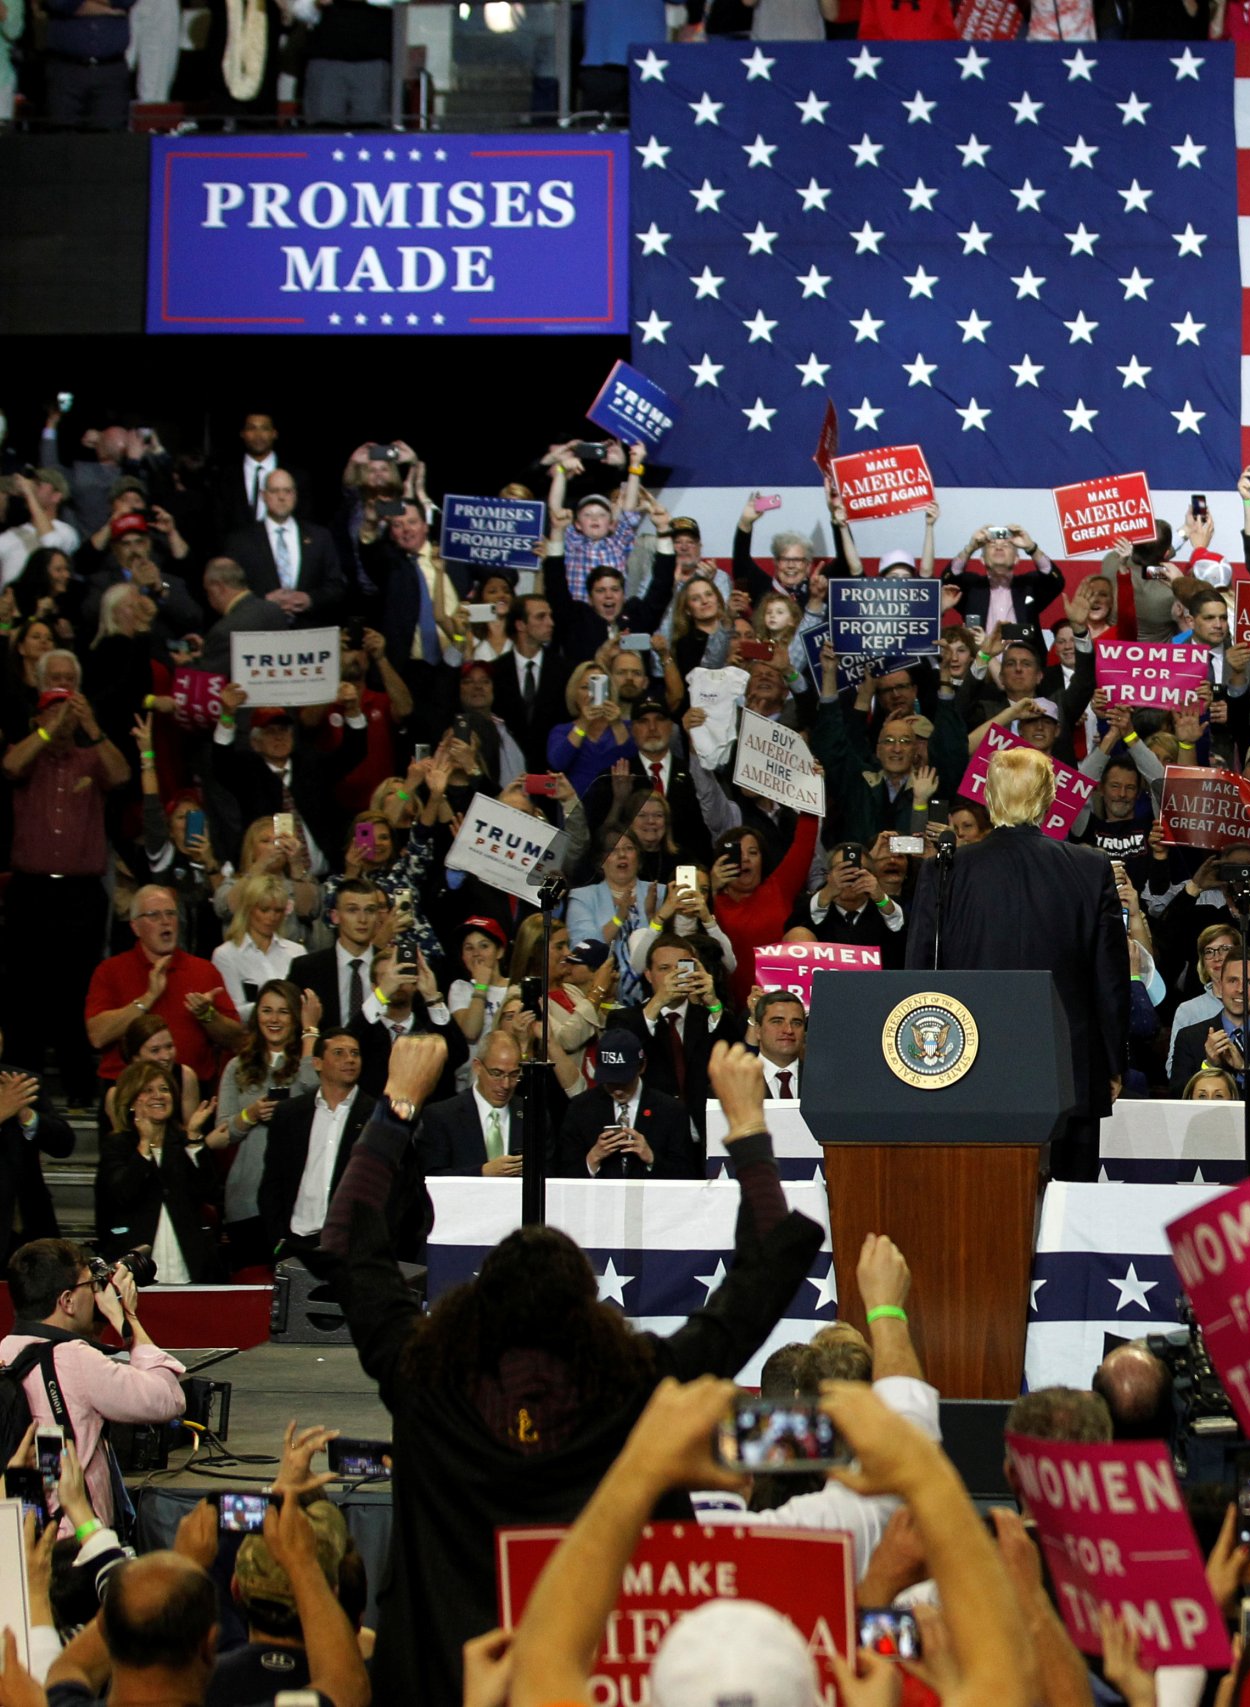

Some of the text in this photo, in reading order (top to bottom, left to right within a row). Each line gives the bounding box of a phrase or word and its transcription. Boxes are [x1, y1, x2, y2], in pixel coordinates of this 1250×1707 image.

[201, 179, 575, 229] PROMISES
[280, 245, 495, 292] MADE
[614, 381, 673, 429] TRUMP
[865, 457, 897, 472] MAKE
[841, 467, 929, 498] AMERICA
[849, 485, 928, 510] GREAT AGAIN
[1087, 488, 1119, 502] MAKE
[454, 503, 535, 522] PROMISES
[1063, 497, 1150, 529] AMERICA
[469, 518, 517, 533] MADE
[1071, 517, 1148, 542] GREAT AGAIN
[450, 532, 532, 550] PROMISES
[469, 547, 510, 561] KEPT
[841, 588, 929, 602] PROMISES
[859, 603, 910, 616] MADE
[840, 621, 929, 635] PROMISES
[862, 636, 906, 649] KEPT
[242, 651, 331, 666] TRUMP
[1099, 644, 1208, 664] WOMEN
[251, 667, 325, 677] PENCE
[1132, 668, 1170, 679] FOR
[1102, 684, 1198, 706] TRUMP
[772, 730, 795, 750] BUY
[745, 734, 816, 777] AMERICAN
[987, 728, 1093, 799] WEN
[766, 760, 792, 781] HIRE
[741, 764, 818, 805] AMERICAN
[1201, 781, 1239, 796] MAKE
[1169, 817, 1215, 832] GREAT
[475, 819, 555, 862] TRUMP
[1096, 834, 1144, 850] TRUMP
[475, 837, 544, 873] PENCE
[756, 944, 880, 965] WOMEN
[942, 999, 954, 1009] THE
[886, 996, 928, 1039] PRESIDENT
[955, 1007, 975, 1047] UNITED
[601, 1051, 626, 1064] USA
[899, 1067, 922, 1084] SEAL
[938, 1055, 970, 1083] STATES
[48, 1380, 62, 1414] Canon
[1011, 1446, 1182, 1514] WOMEN
[1063, 1533, 1127, 1578] FOR
[622, 1561, 739, 1597] MAKE
[1060, 1582, 1209, 1651] TRMP
